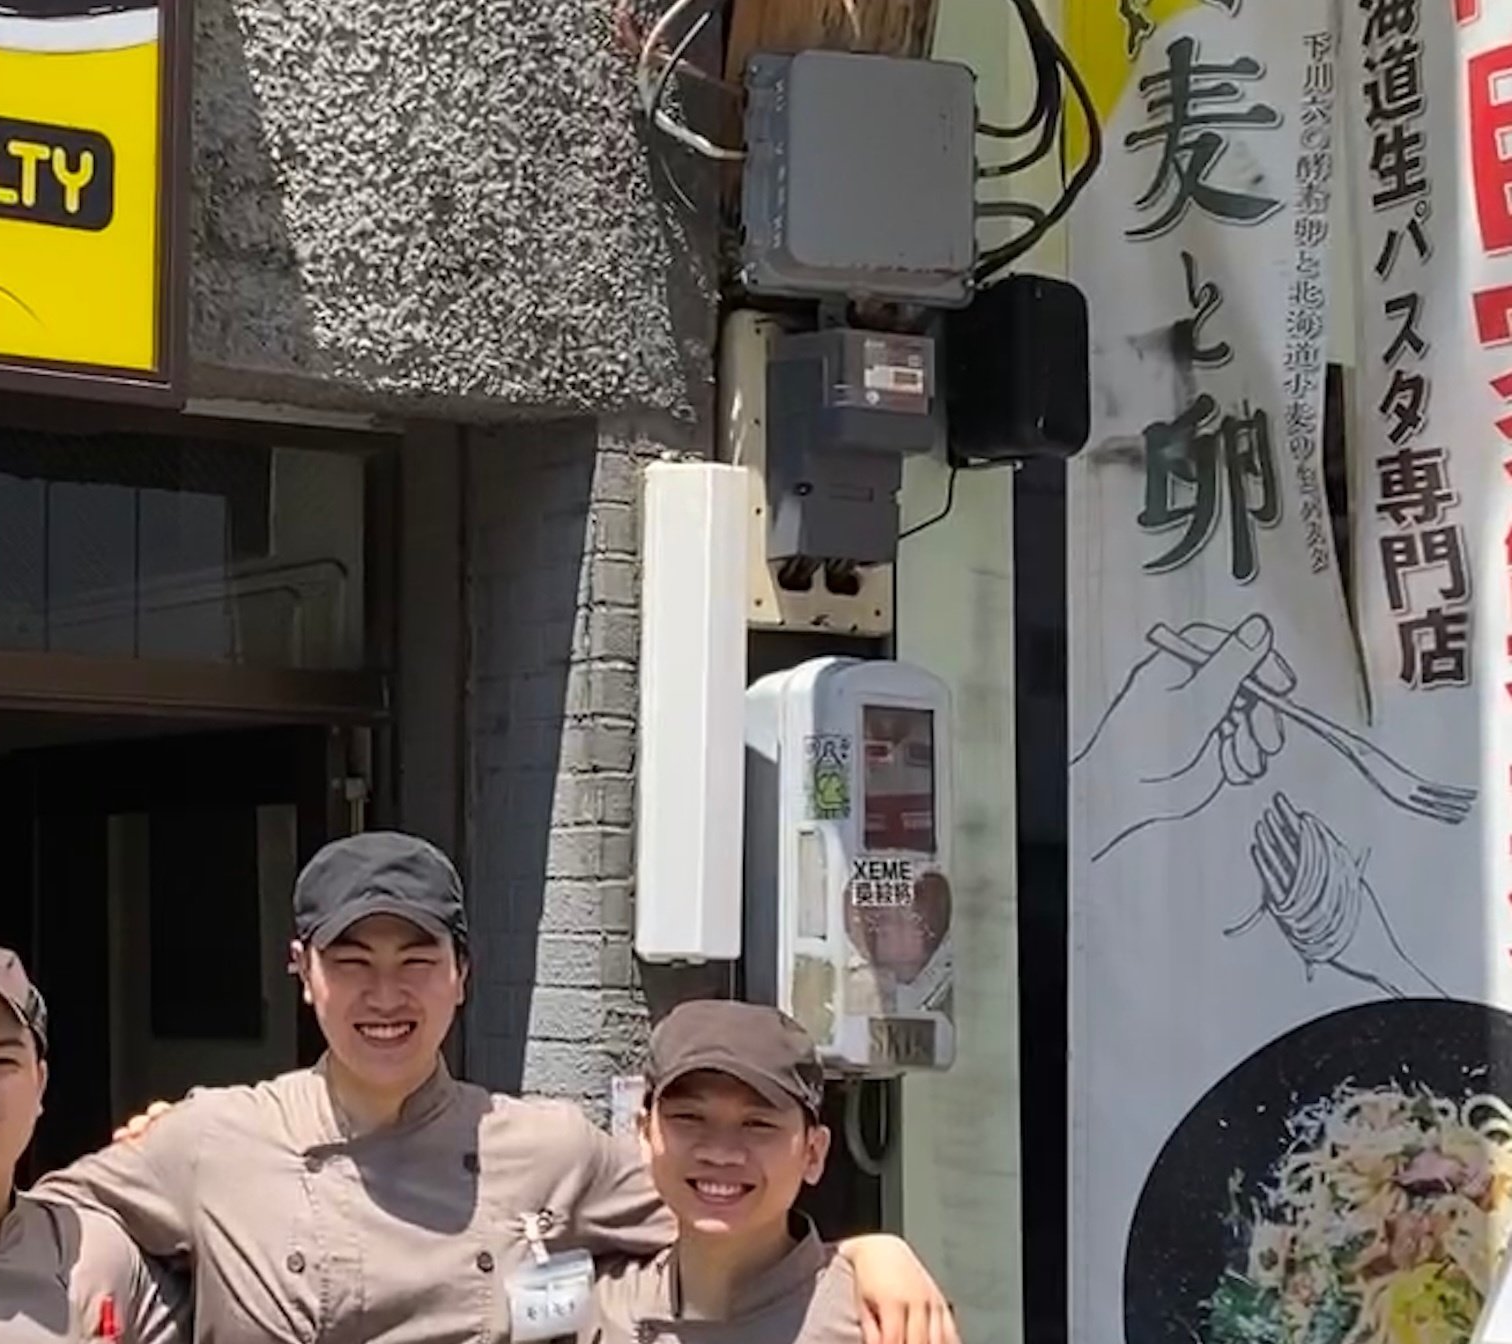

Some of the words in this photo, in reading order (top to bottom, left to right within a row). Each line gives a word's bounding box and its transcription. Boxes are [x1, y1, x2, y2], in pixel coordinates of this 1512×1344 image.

[1124, 34, 1284, 582] 麦と卵
[853, 860, 911, 881] XEME
